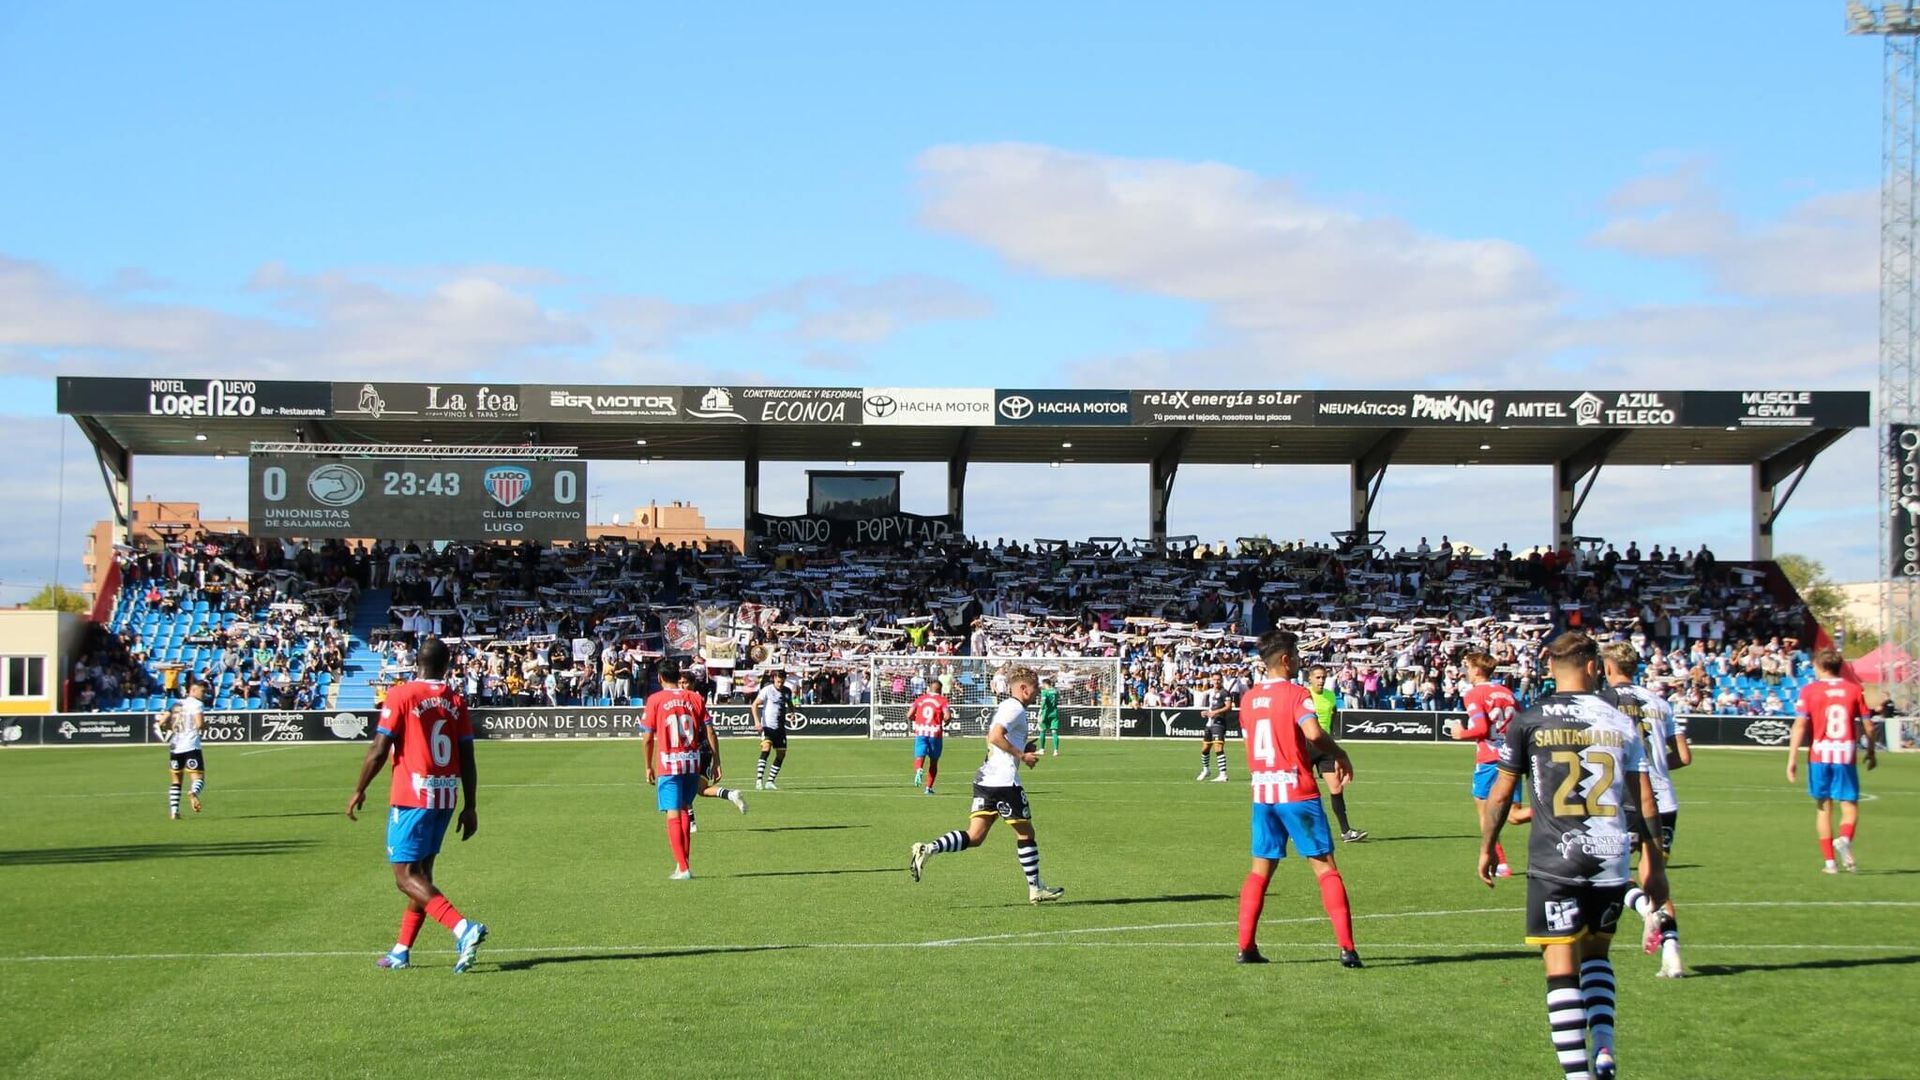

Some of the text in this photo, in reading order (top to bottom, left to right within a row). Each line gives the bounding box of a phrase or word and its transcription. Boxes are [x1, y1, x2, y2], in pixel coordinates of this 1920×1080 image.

[151, 380, 187, 393] HOTEL
[426, 386, 519, 411] La fea
[743, 390, 863, 399] CONSTRUCCIONES Y REFORMAS
[1192, 392, 1253, 408] energía
[1257, 392, 1302, 405] solar
[1616, 394, 1663, 408] AZUL
[1742, 392, 1811, 404] MUSCLE
[597, 396, 676, 411] MOTOR
[900, 402, 990, 412] HACHA MOTOR
[1038, 402, 1128, 413] HACHA MOTOR
[1319, 401, 1406, 416] NEUMÁTICOS
[1505, 402, 1566, 418] AMTEL
[1758, 405, 1796, 416] GYM
[261, 407, 274, 415] Bar
[280, 407, 326, 416] Restaurante
[761, 402, 846, 422] ECONOA
[1267, 414, 1292, 422] placas
[1605, 408, 1676, 424] TELECO
[263, 466, 286, 501] 0
[384, 472, 460, 496] 23:43
[554, 470, 576, 504] 0
[266, 510, 350, 518] UNIONISTAS
[482, 510, 580, 519] CLUB DEPORTIVO
[283, 520, 350, 528] SALAMANCA
[484, 523, 524, 532] LUGO
[765, 519, 830, 542] FONDO
[486, 713, 642, 729] SARDÓN DE LOS FRA
[922, 706, 934, 724] 9
[1826, 704, 1847, 740] 8
[666, 714, 694, 748] 19
[1172, 728, 1205, 736] Helman
[431, 720, 452, 767] 6
[1254, 718, 1276, 768] 4
[1552, 751, 1616, 817] 22
